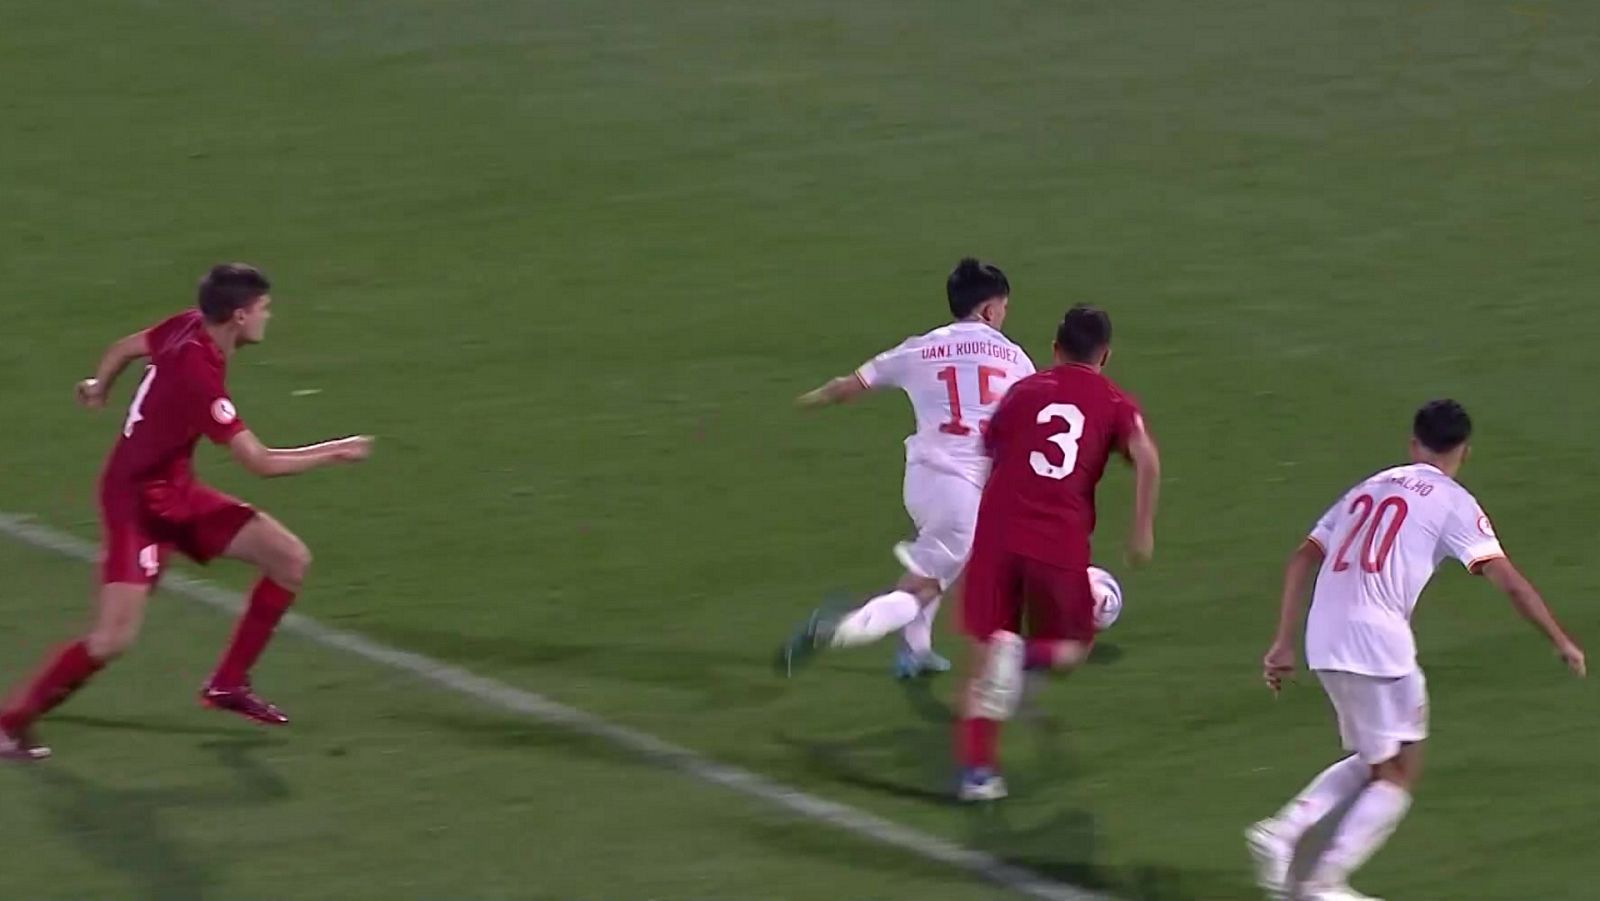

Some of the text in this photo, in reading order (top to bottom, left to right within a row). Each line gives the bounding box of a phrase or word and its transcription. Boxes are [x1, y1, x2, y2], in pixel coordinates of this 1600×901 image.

[921, 339, 1018, 364] DANI RODRÍGUEZ
[937, 364, 1008, 436] 15
[1029, 402, 1086, 480] 3
[1332, 494, 1409, 574] 20
